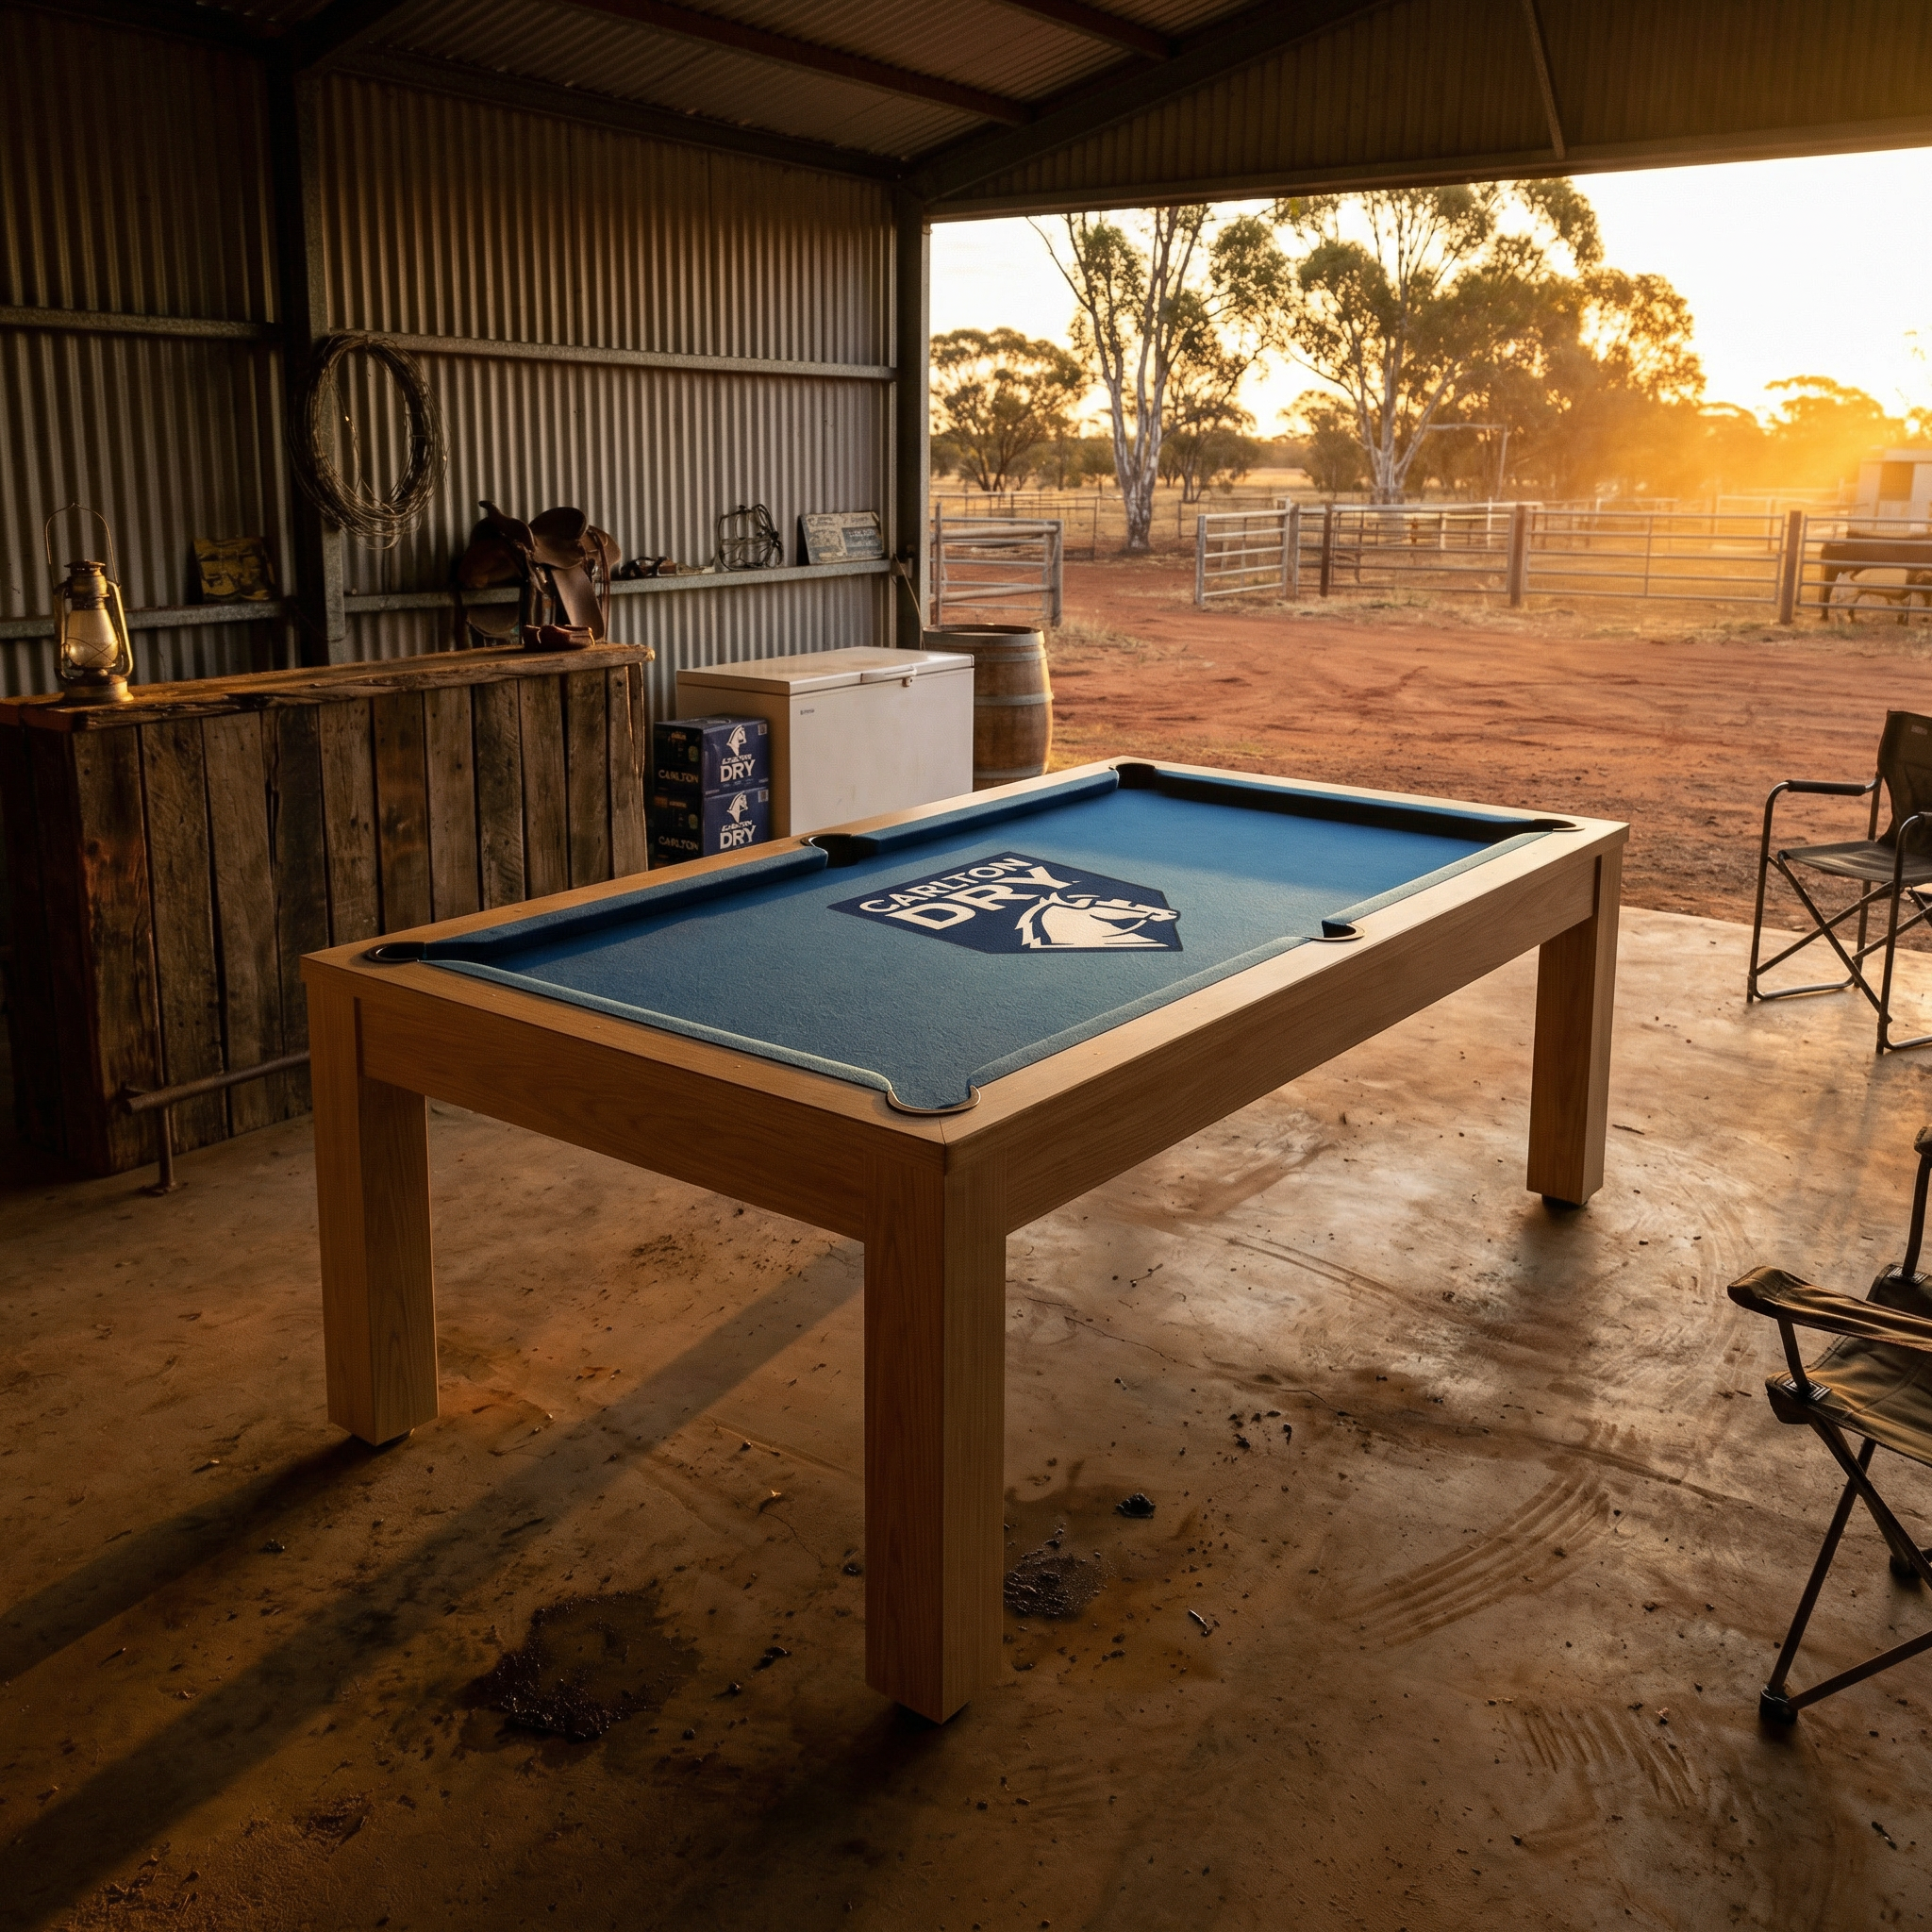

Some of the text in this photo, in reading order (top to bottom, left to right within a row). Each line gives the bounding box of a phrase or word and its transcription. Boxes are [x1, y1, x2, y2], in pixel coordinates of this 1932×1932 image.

[720, 758, 756, 783] DRY
[720, 824, 756, 849] DRY
[858, 858, 1033, 913] CARLTON
[885, 865, 1073, 930] DRY
